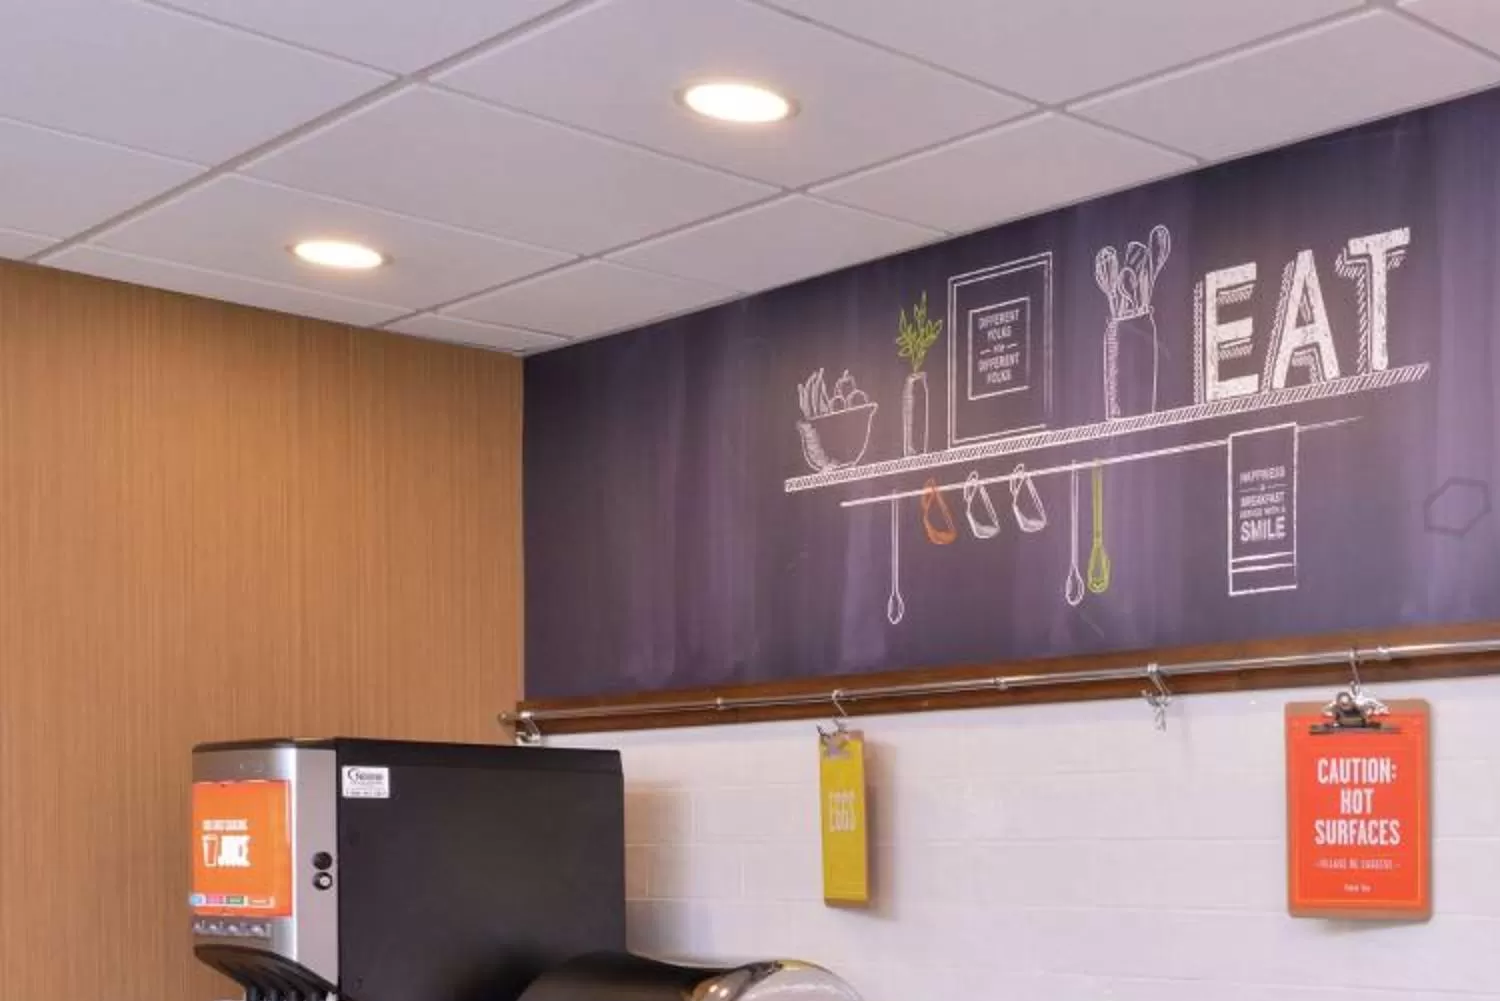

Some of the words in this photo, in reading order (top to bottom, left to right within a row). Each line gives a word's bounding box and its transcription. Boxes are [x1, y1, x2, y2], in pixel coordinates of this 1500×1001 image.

[1193, 227, 1410, 405] EAT
[1240, 515, 1287, 542] SMILE
[1316, 757, 1398, 785] CAUTION:
[1339, 788, 1375, 815] HOT
[1314, 818, 1401, 846] SURFACES
